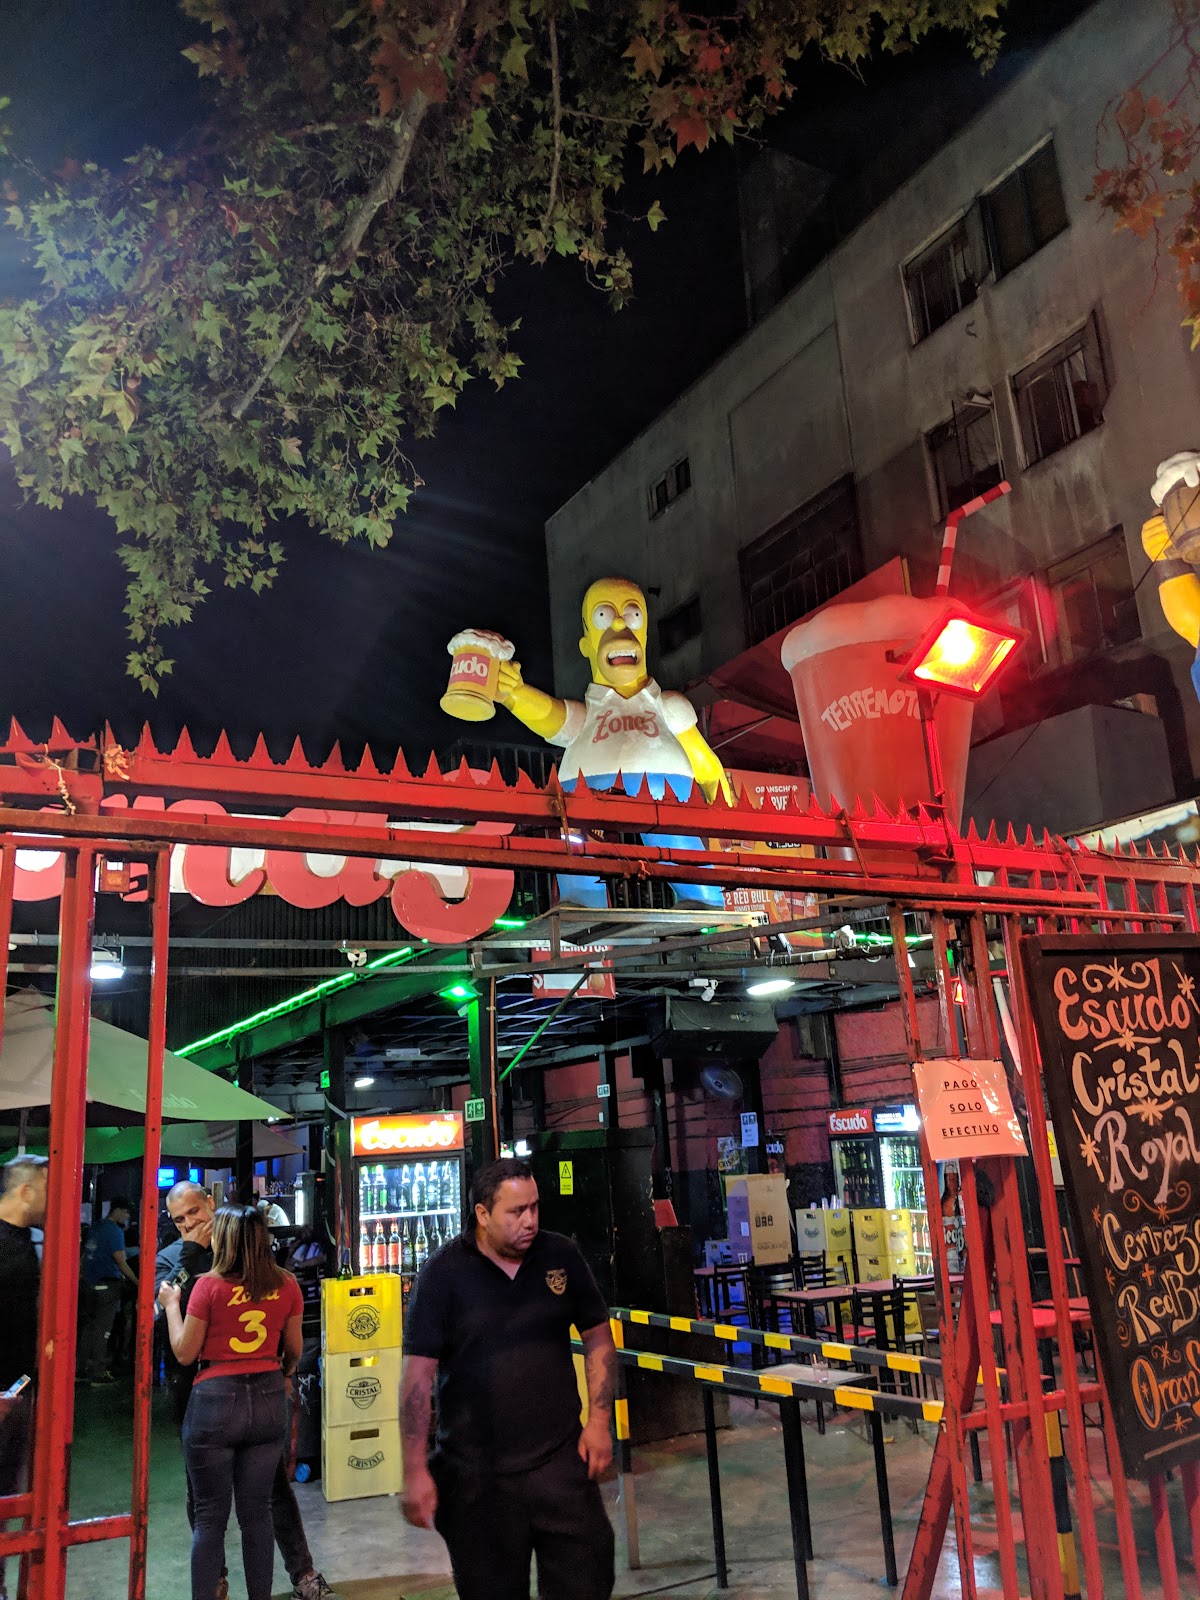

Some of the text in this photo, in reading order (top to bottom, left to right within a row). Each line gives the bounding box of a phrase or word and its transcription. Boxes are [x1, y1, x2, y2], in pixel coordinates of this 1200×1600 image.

[725, 892, 733, 906] 2
[733, 891, 750, 905] RED
[750, 889, 771, 903] BULL
[1054, 957, 1191, 1041] Escudo
[944, 1079, 978, 1090] PAGO
[1072, 1038, 1200, 1116] Cristal
[949, 1101, 982, 1112] SOLO
[829, 1112, 867, 1132] Escudo
[941, 1124, 999, 1137] EFECTIVO
[228, 1309, 268, 1354] 3
[349, 1386, 378, 1396] CRISTAL
[350, 1456, 381, 1468] CRISTAL
